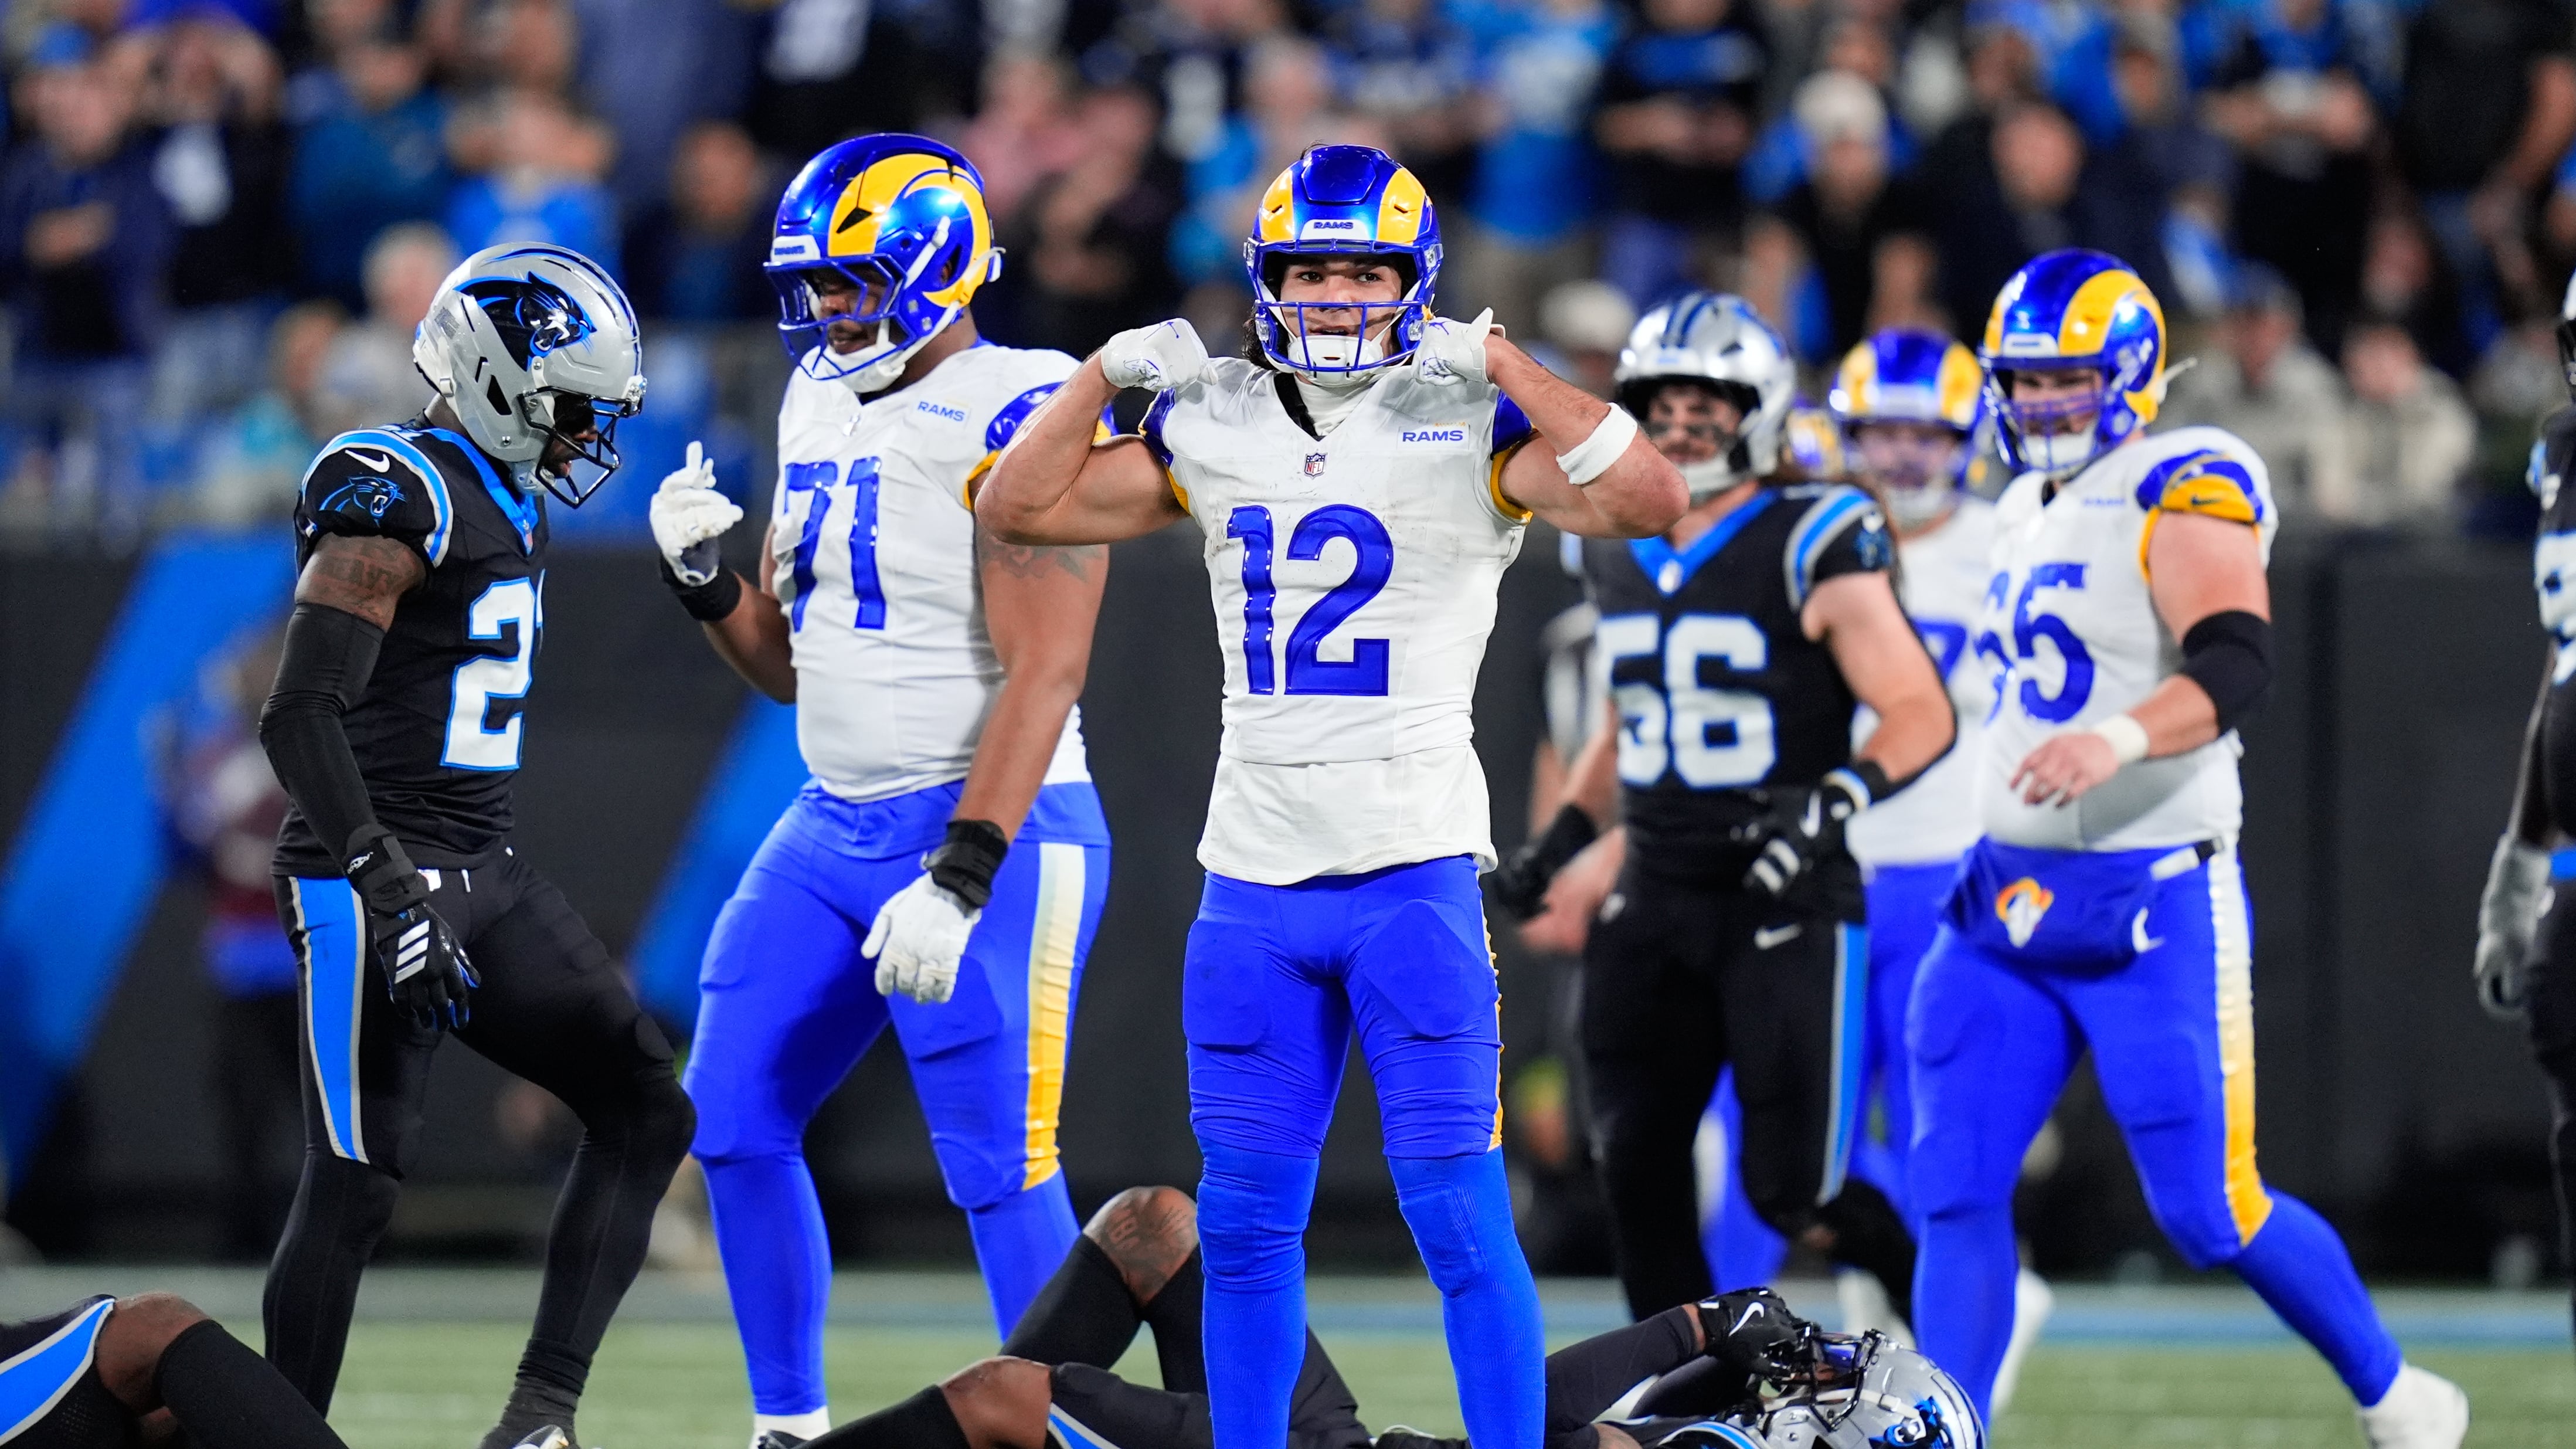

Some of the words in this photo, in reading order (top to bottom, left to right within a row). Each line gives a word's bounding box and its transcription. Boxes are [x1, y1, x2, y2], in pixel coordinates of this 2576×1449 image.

[917, 401, 965, 422] RAMS
[1402, 430, 1463, 442] RAMS
[784, 456, 887, 633] 71
[1227, 504, 1394, 696] 12
[440, 568, 546, 771] 2
[1593, 613, 1779, 789] 56
